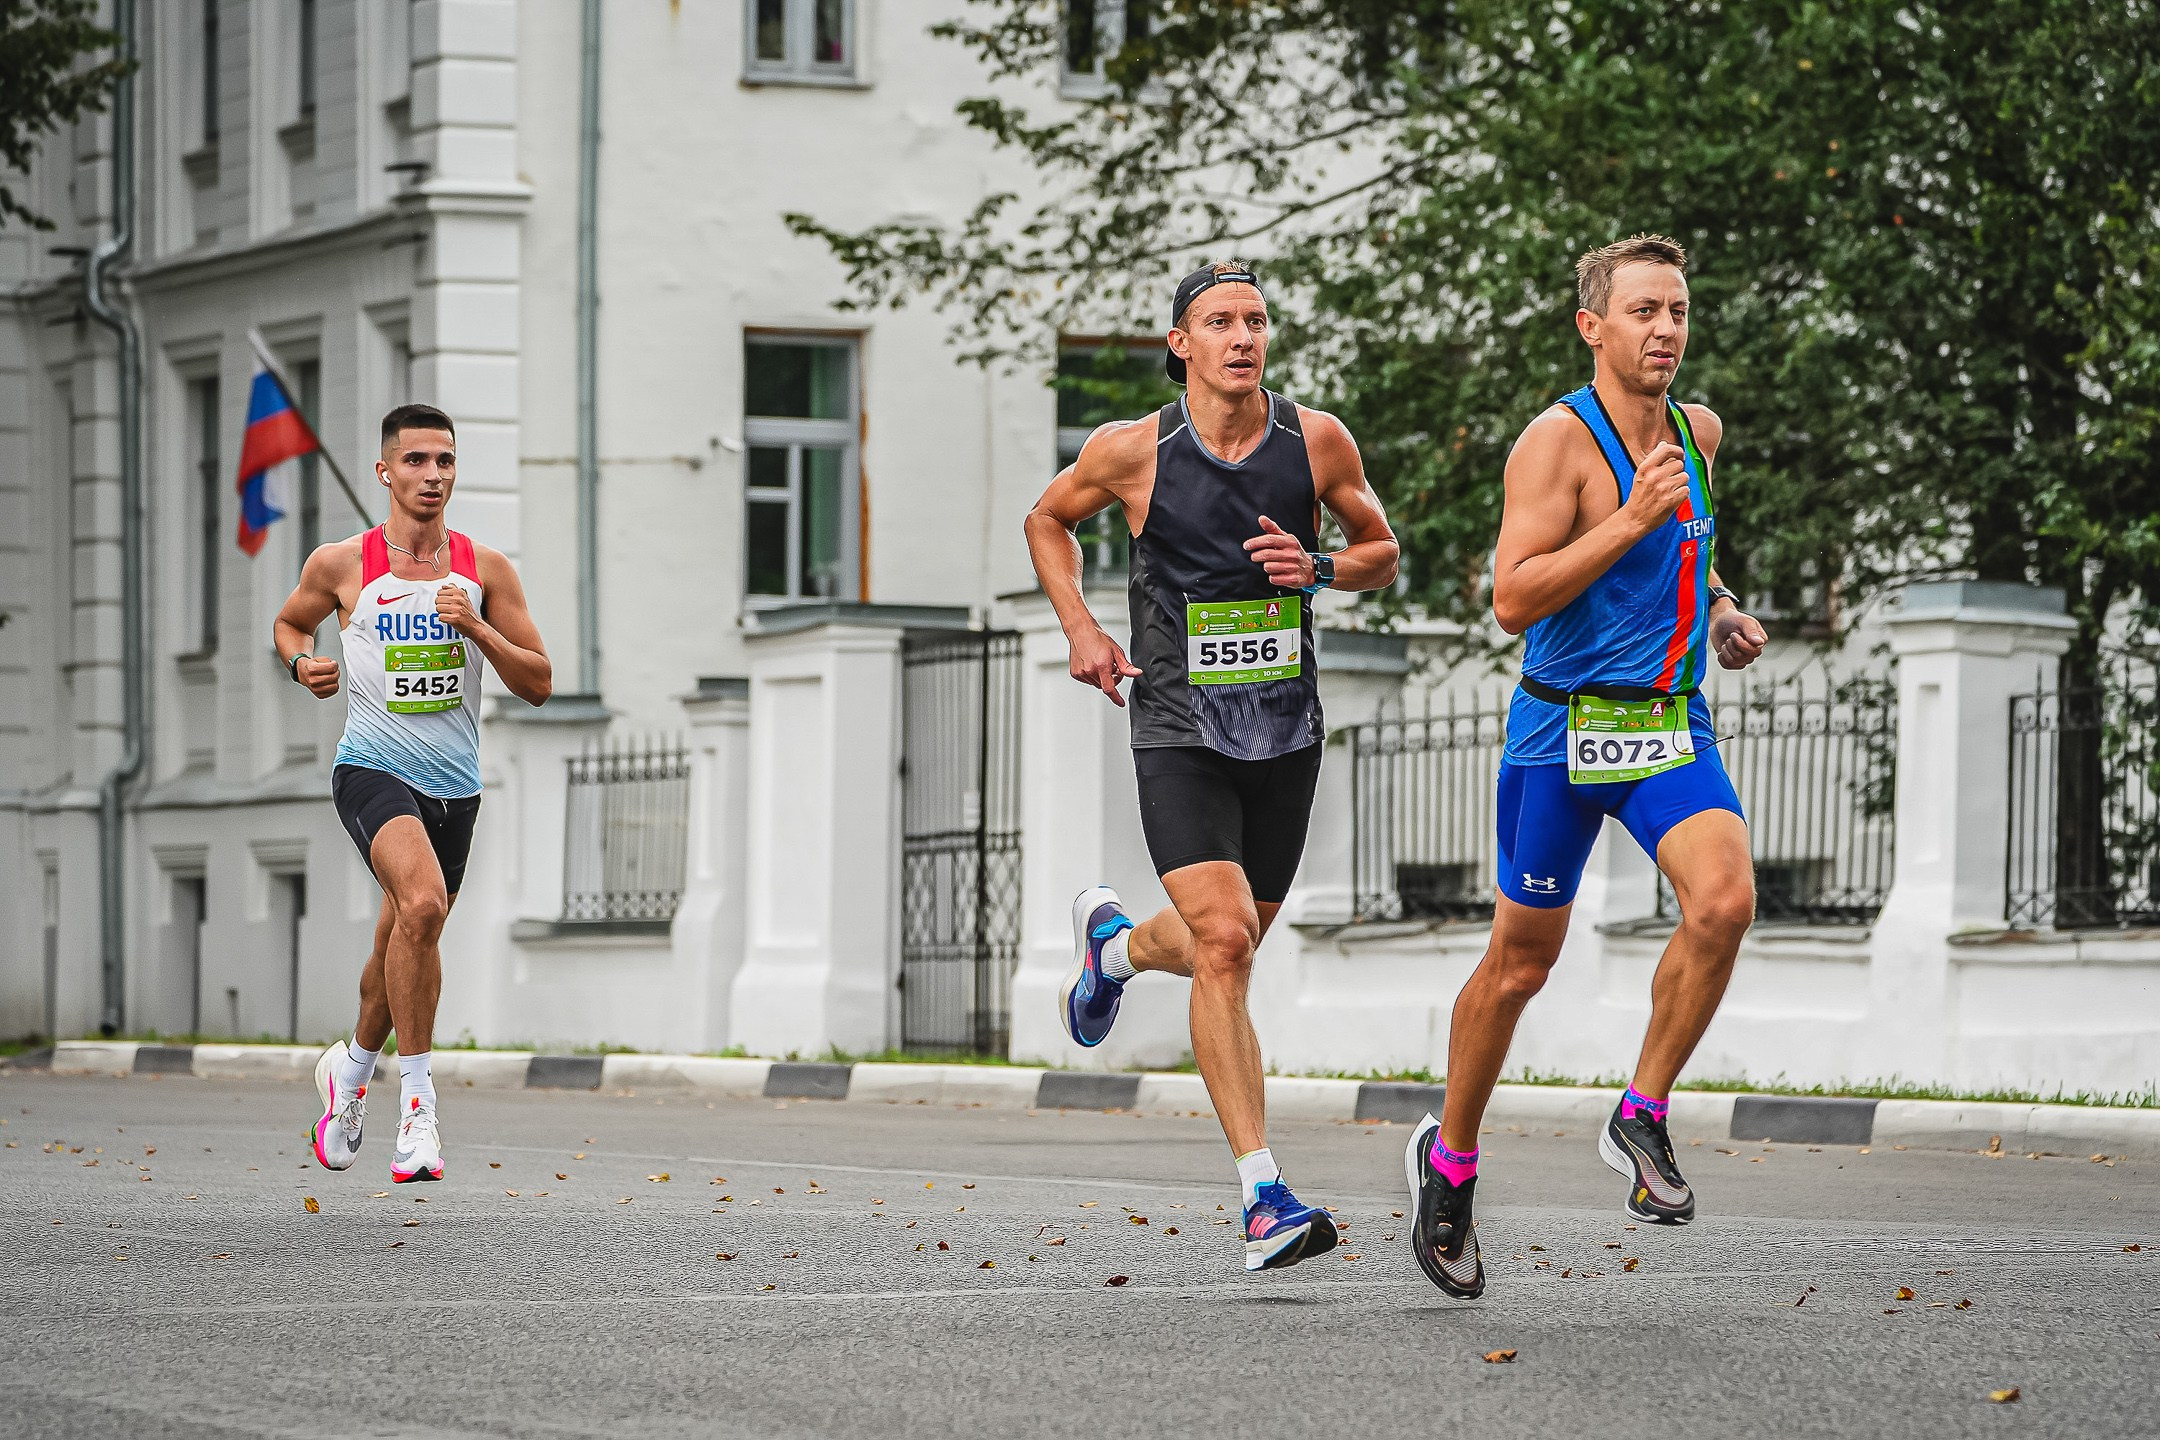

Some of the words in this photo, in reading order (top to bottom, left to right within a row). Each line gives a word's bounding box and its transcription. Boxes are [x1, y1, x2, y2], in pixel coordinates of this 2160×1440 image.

[375, 613, 466, 641] RUSSI
[1199, 637, 1279, 666] 5556
[394, 674, 459, 697] 5452
[1579, 738, 1667, 765] 6072
